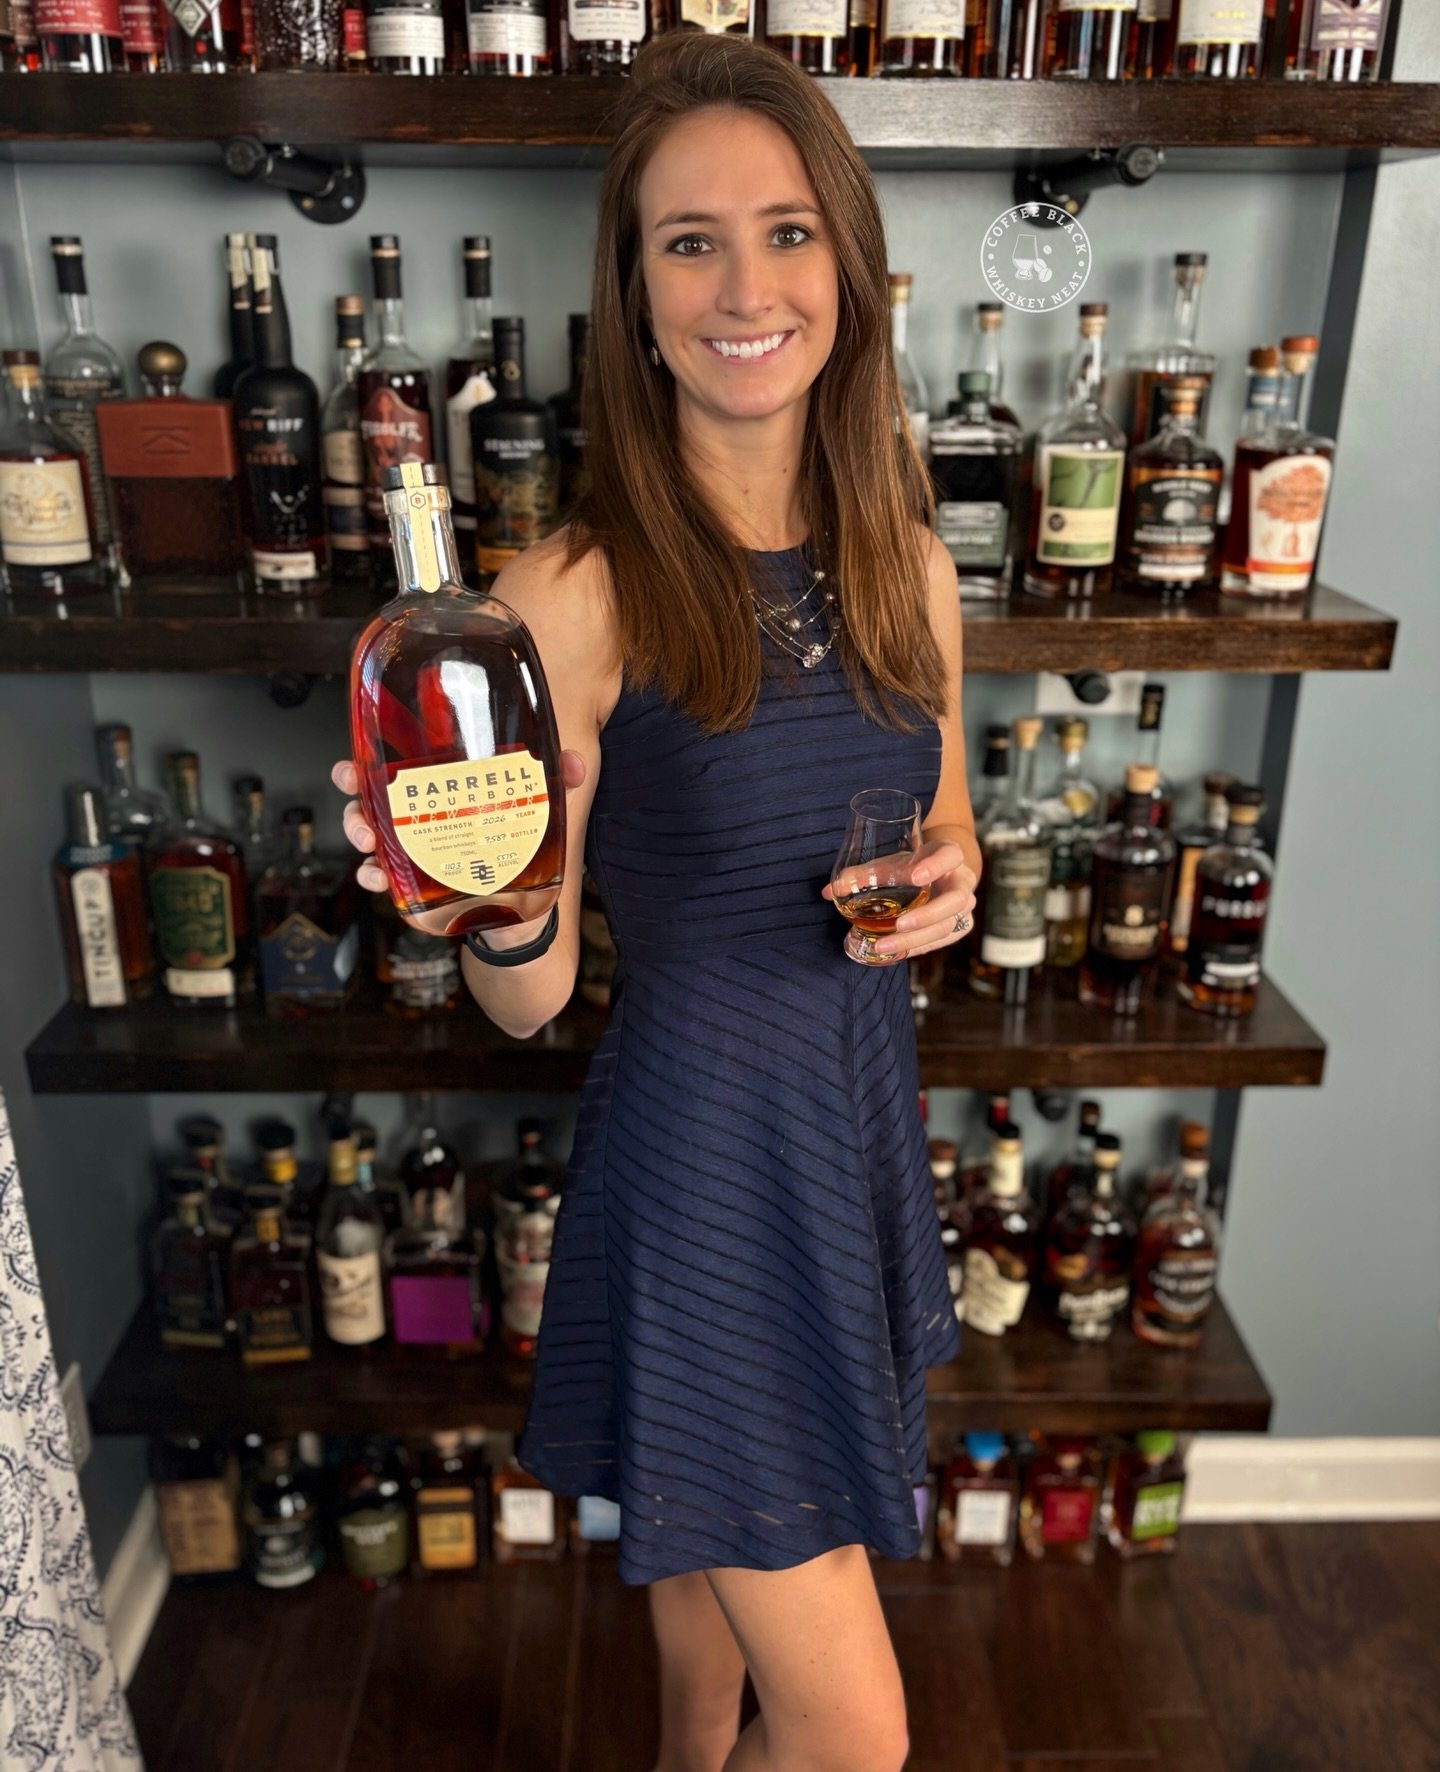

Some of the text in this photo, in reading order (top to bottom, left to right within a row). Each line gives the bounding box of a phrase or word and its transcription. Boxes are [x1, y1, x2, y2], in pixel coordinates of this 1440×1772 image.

[267, 418, 304, 432] RIFF
[406, 768, 531, 797] BARRELL
[409, 784, 533, 811] BOURBON
[411, 809, 458, 824] NEW
[482, 815, 506, 825] 2026
[435, 822, 473, 832] STRENGTH
